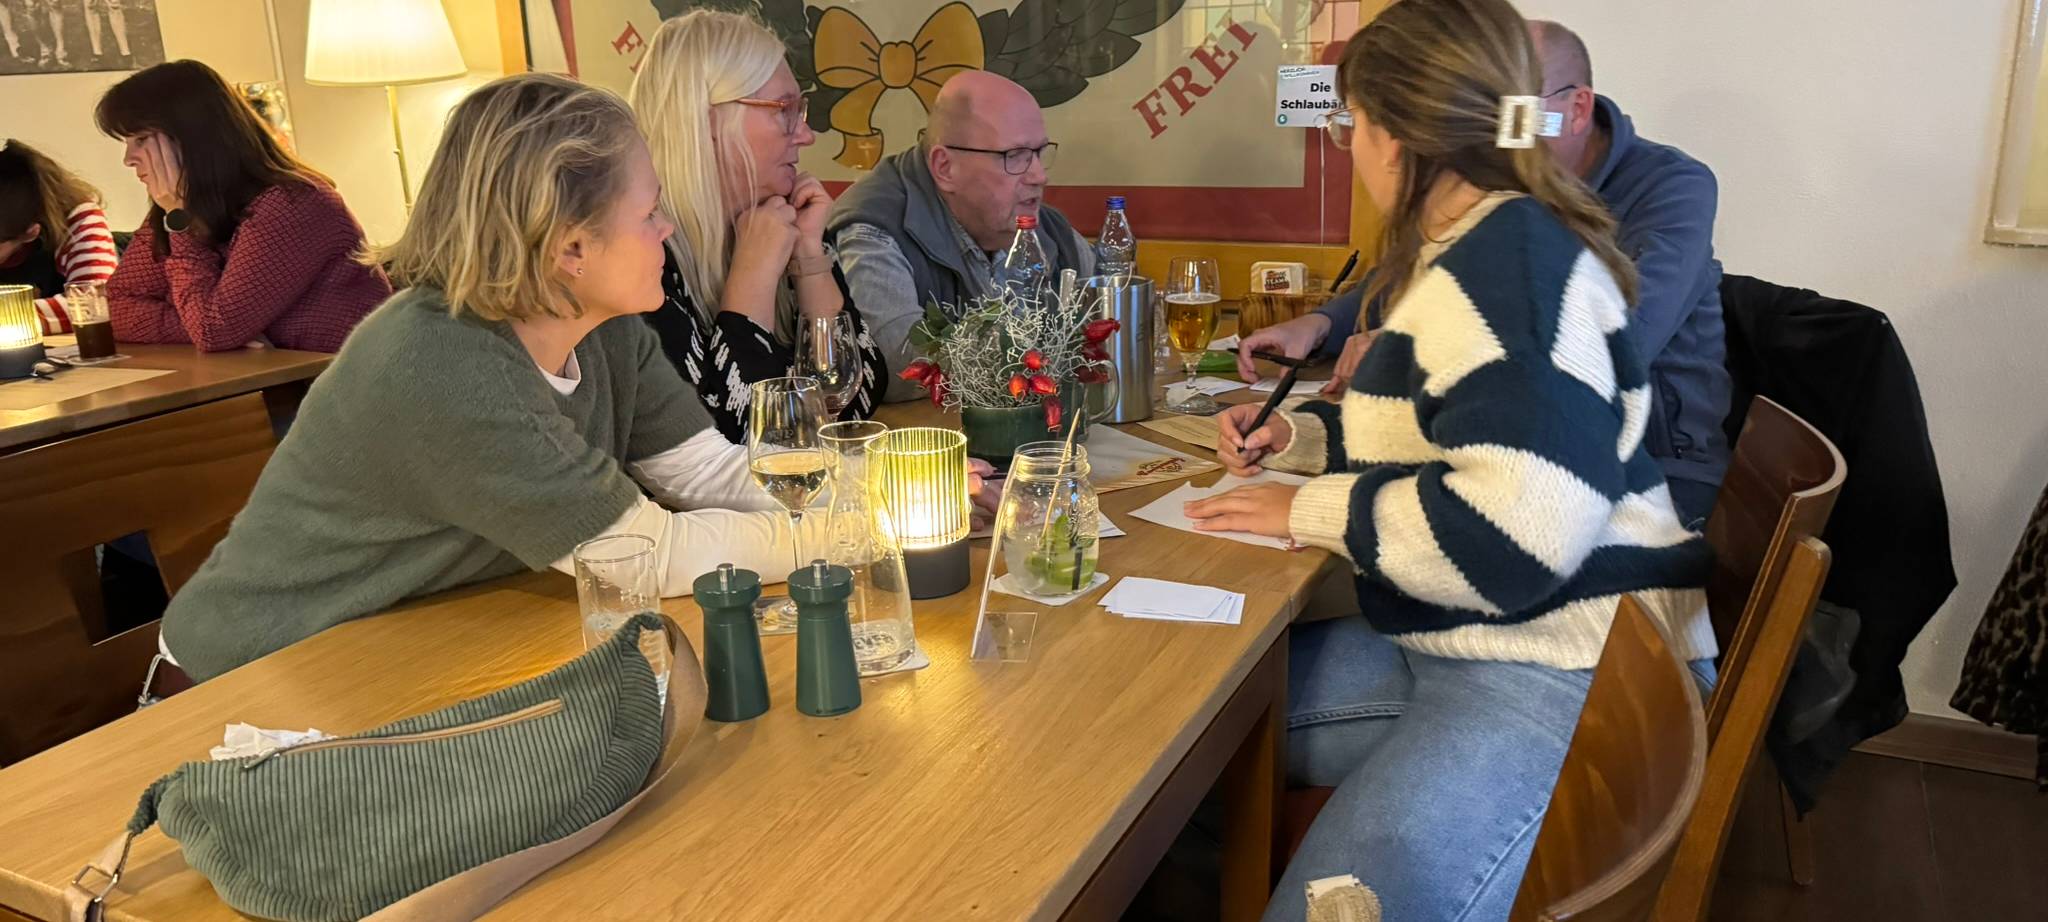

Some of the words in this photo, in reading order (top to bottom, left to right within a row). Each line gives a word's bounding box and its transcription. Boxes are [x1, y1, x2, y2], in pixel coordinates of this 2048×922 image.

[1132, 9, 1257, 139] FREI
[1310, 82, 1331, 92] Die
[1280, 99, 1344, 109] Schlaubär
